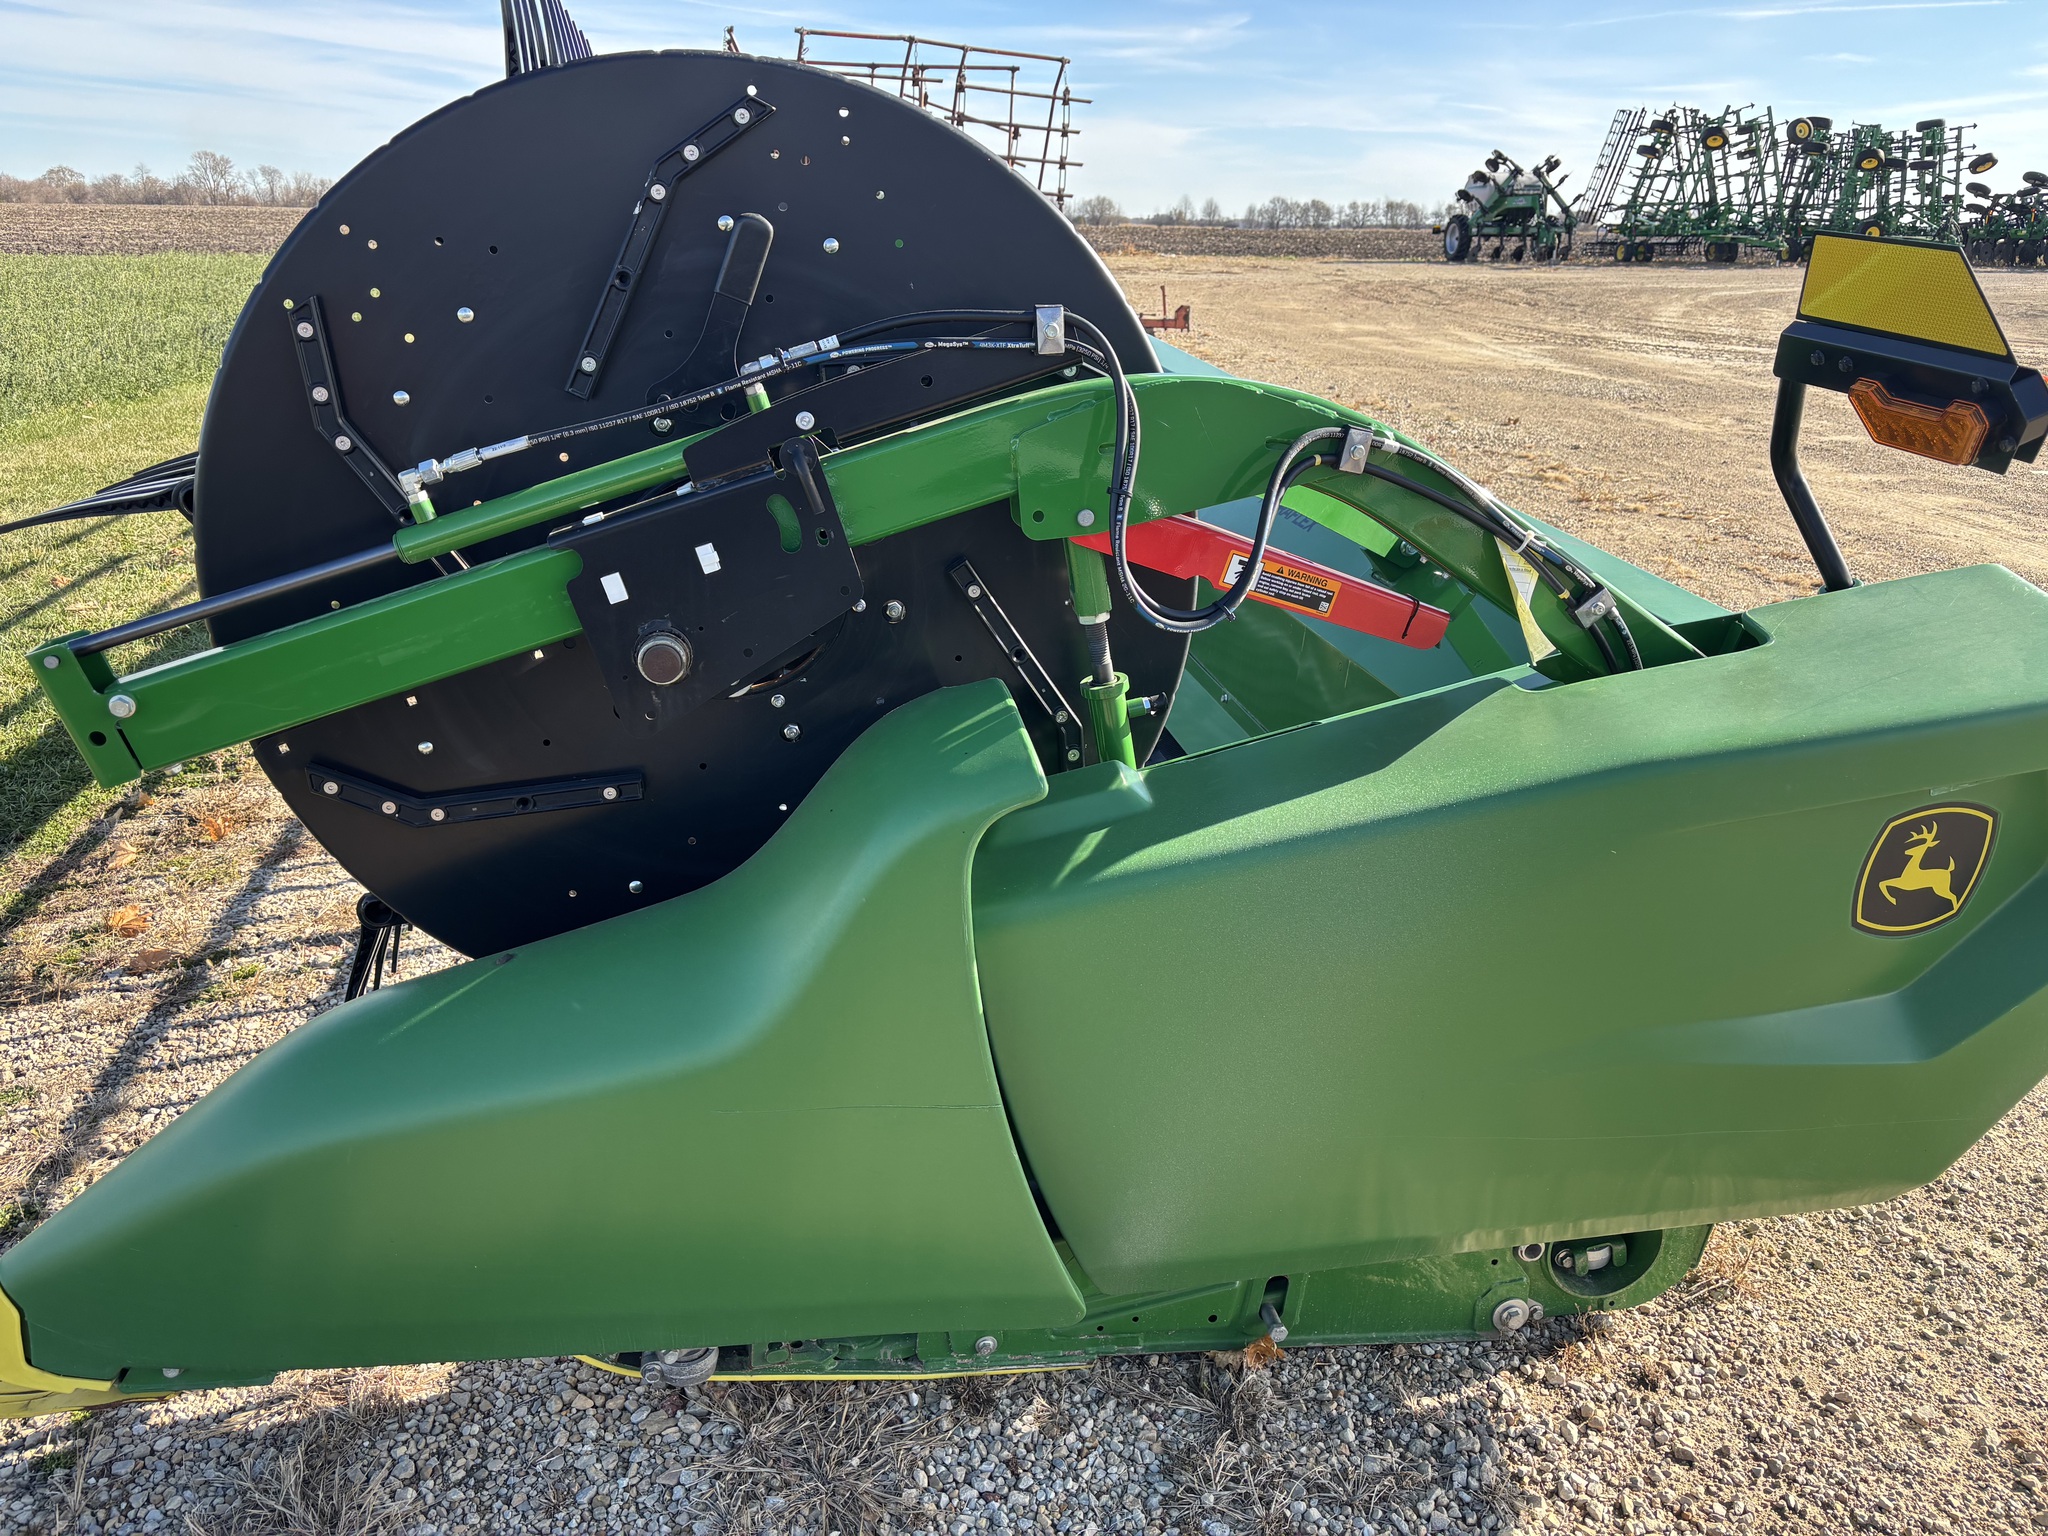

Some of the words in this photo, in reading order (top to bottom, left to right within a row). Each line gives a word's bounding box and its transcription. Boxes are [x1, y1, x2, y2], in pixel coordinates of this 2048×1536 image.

[697, 392, 709, 401] Type
[724, 382, 741, 391] Flame
[742, 373, 767, 388] Resistant
[766, 367, 782, 376] MSHA
[1288, 568, 1328, 587] WARNING
